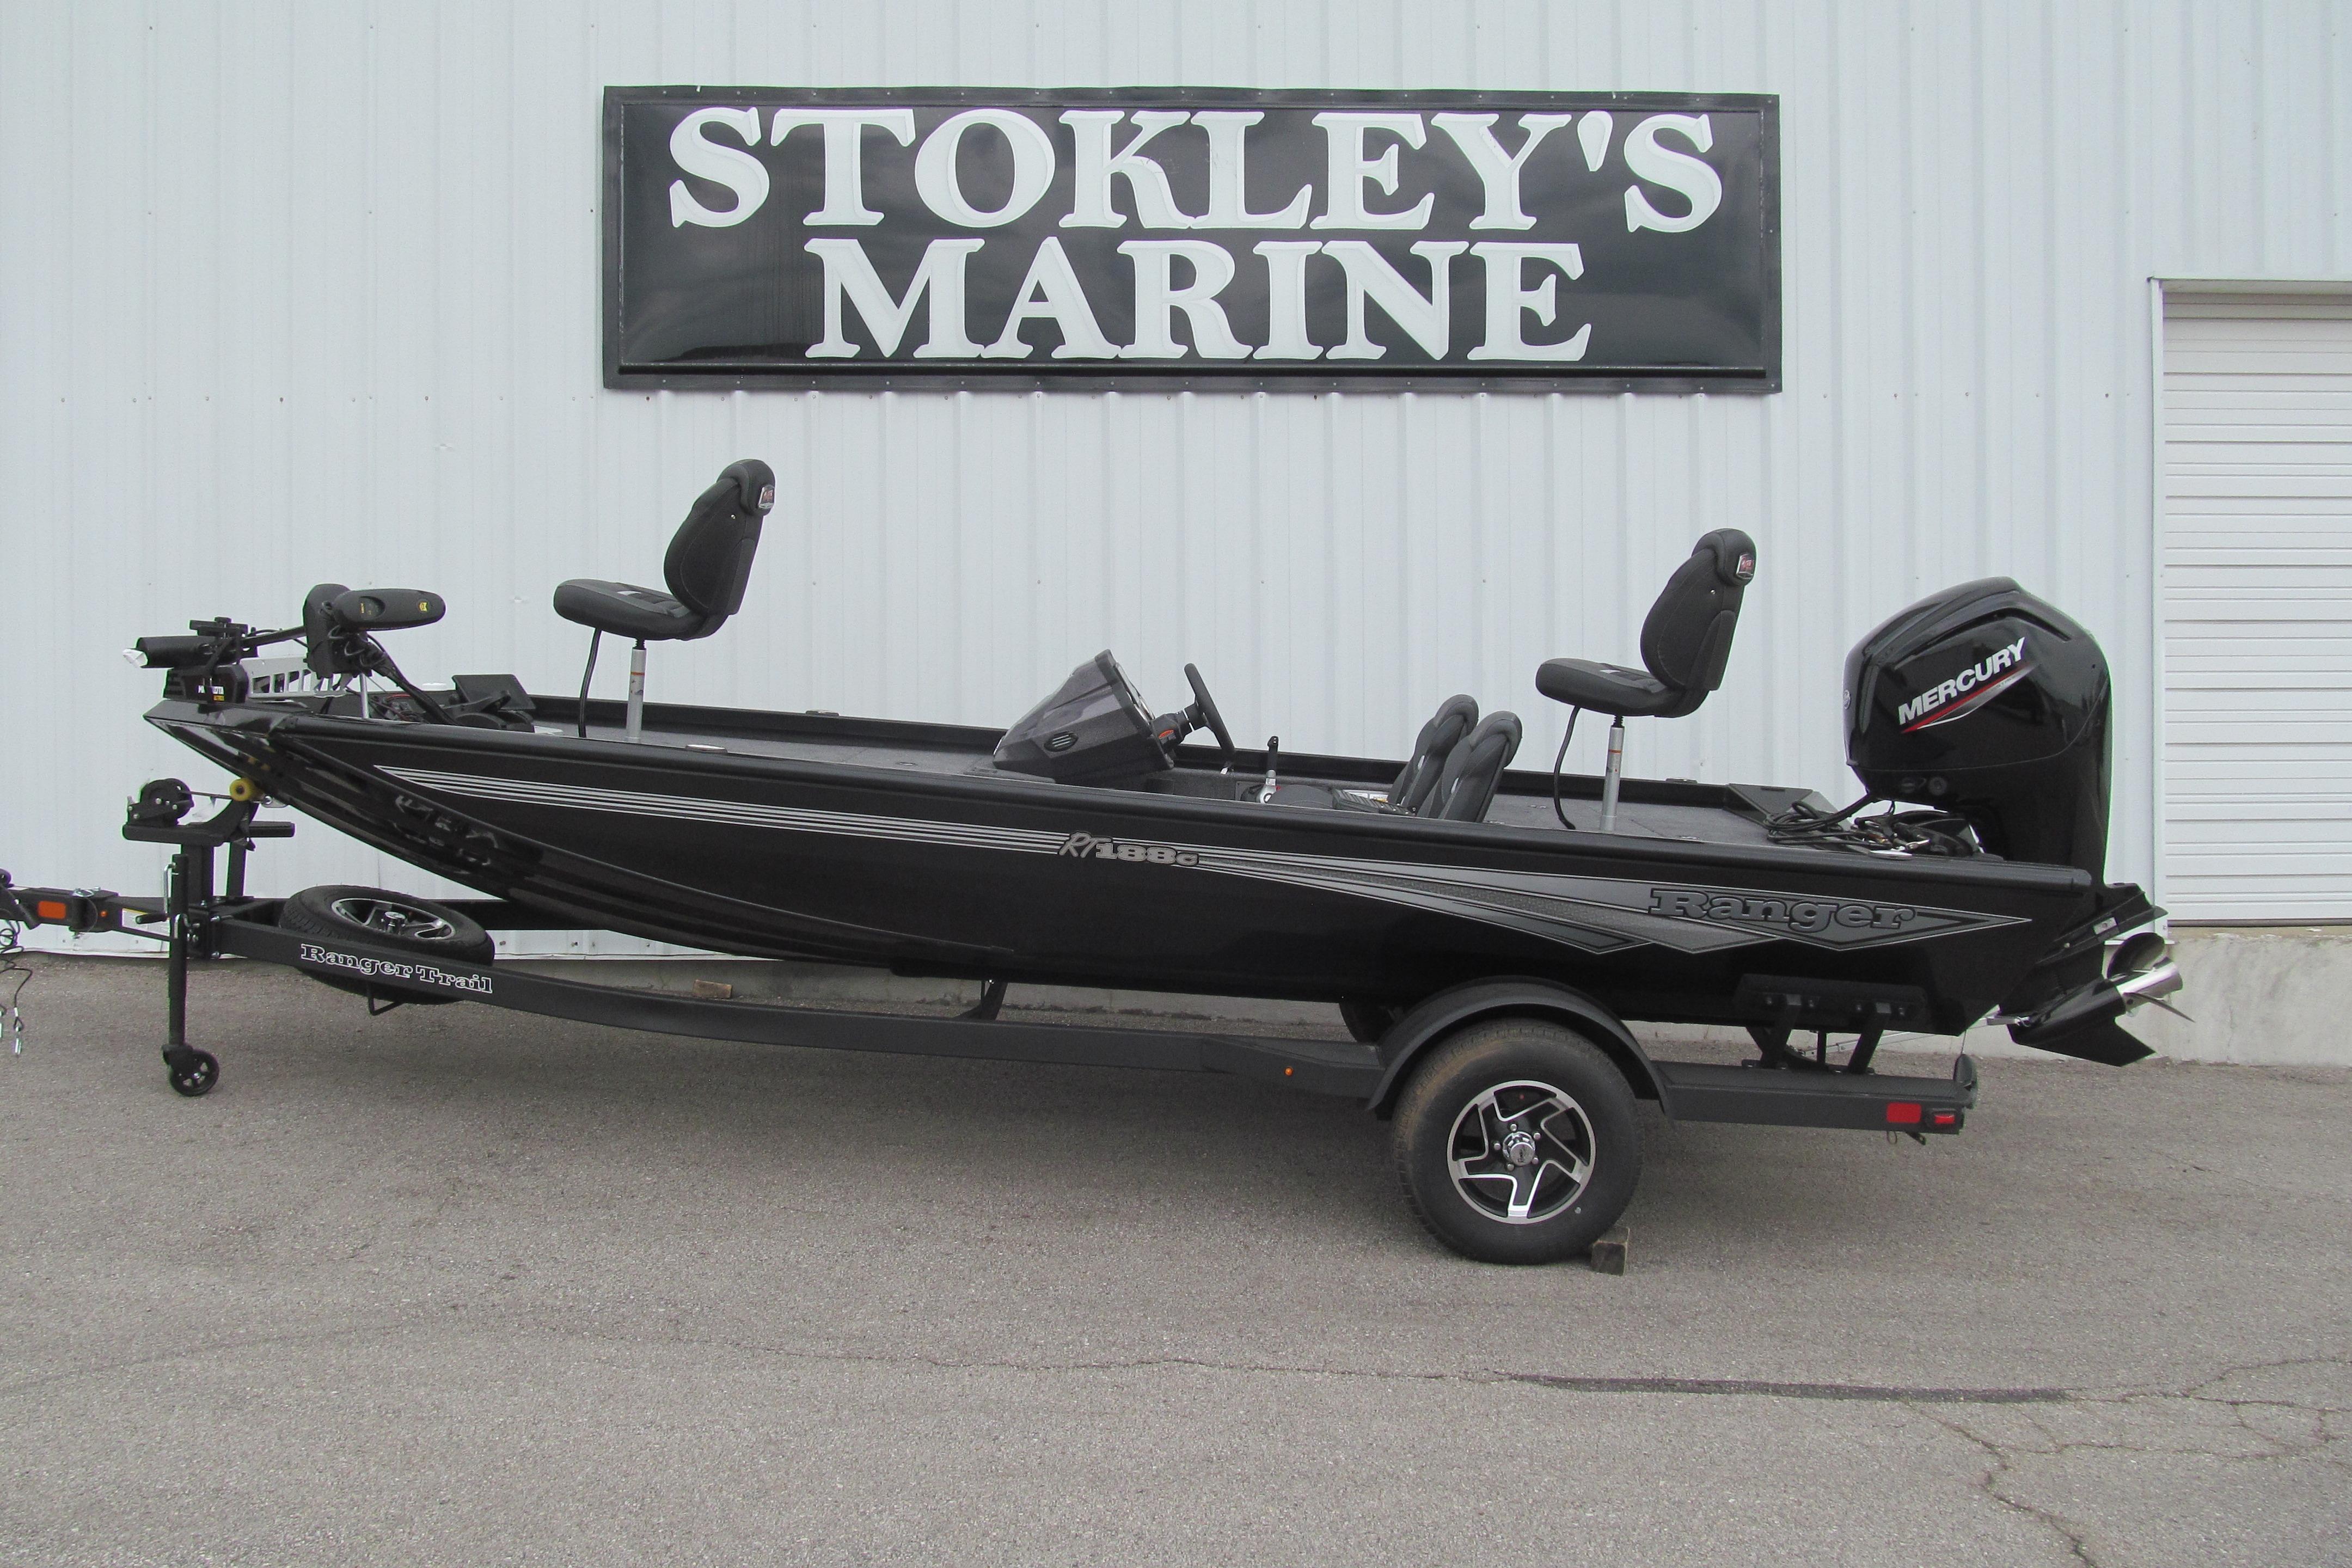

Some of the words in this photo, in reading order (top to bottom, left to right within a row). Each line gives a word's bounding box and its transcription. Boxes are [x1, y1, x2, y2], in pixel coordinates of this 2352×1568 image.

[669, 107, 1723, 233] STOKLEY'S
[804, 236, 1592, 362] MARINE
[1898, 637, 2025, 725] MERCURY
[1649, 889, 1915, 933] Ranger
[301, 944, 413, 978] Ranger
[415, 964, 493, 994] Trail
